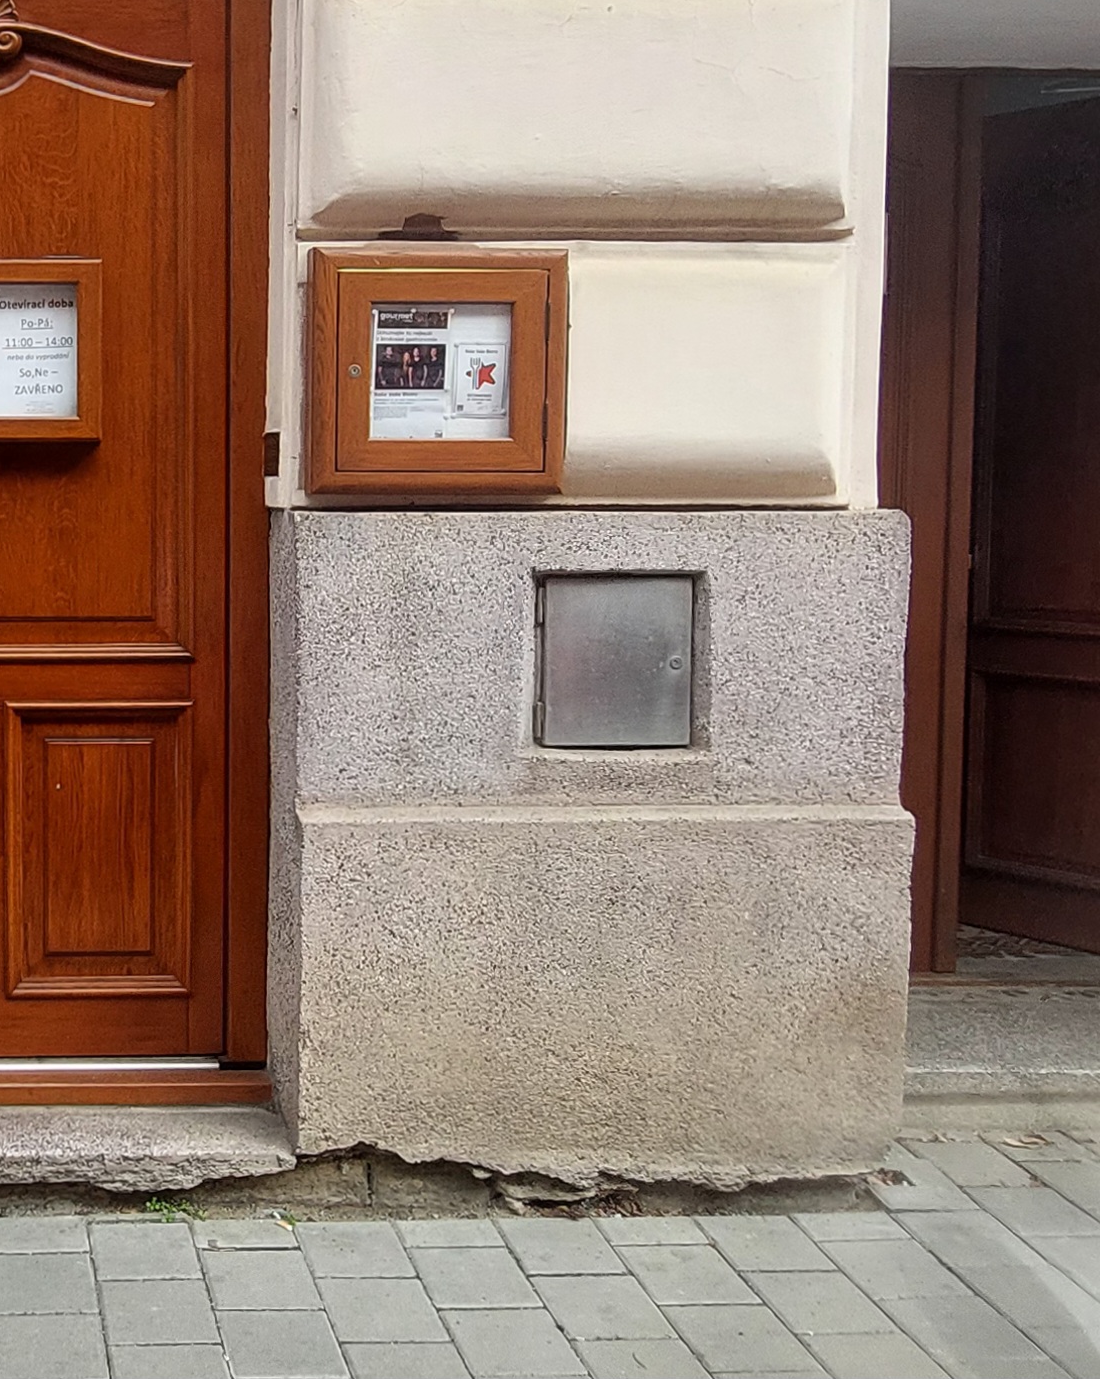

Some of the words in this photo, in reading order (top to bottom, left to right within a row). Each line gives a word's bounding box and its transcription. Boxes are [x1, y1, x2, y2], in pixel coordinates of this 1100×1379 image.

[47, 298, 74, 309] doba
[5, 337, 33, 347] 11:00
[45, 336, 74, 346] 14:00
[19, 368, 49, 378] So,Ne
